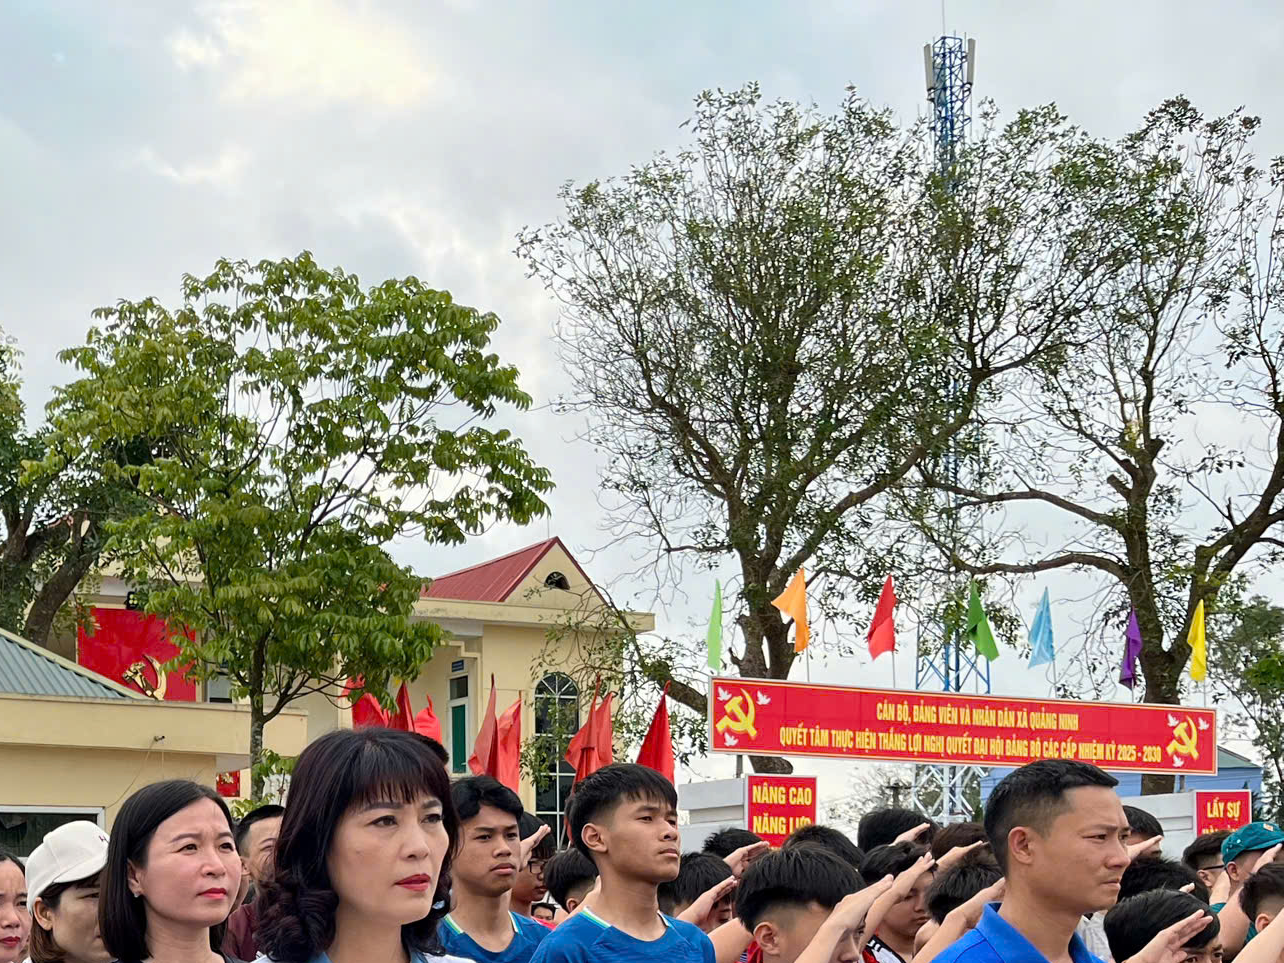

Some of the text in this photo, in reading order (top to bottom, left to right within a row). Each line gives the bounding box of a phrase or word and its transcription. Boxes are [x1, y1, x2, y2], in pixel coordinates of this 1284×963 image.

[876, 699, 895, 721] CÁN
[913, 699, 937, 724] ĐẢNG
[938, 703, 958, 725] VIÊN
[959, 704, 971, 726] VÀ
[972, 705, 996, 727] NHÂN
[997, 707, 1015, 728] DÂN
[1016, 708, 1028, 728] XÃ
[1029, 707, 1057, 730] QUẢNG
[1058, 713, 1079, 731] NINH
[779, 721, 808, 748] QUYẾT
[809, 725, 829, 748] TÂM
[831, 729, 854, 752] THỰC
[855, 728, 876, 753] HIỆN
[878, 727, 906, 752] THẮNG
[908, 733, 922, 756] LỢI
[924, 735, 945, 757] NGHỊ
[946, 731, 972, 756] QUYẾT
[973, 737, 988, 759] ĐẠI
[989, 735, 1004, 760] HỘI
[1005, 733, 1029, 757] ĐẢNG
[1043, 737, 1059, 759] CÁC
[1060, 736, 1077, 759] CẤP
[1078, 739, 1105, 763] NHIỆM
[1105, 740, 1117, 761] KỲ
[1117, 744, 1137, 762] 2025
[1142, 745, 1162, 763] 2030
[752, 782, 813, 806] NÂNG CAO
[1207, 796, 1242, 821] LẤY SỰ
[752, 812, 787, 835] NĂNG
